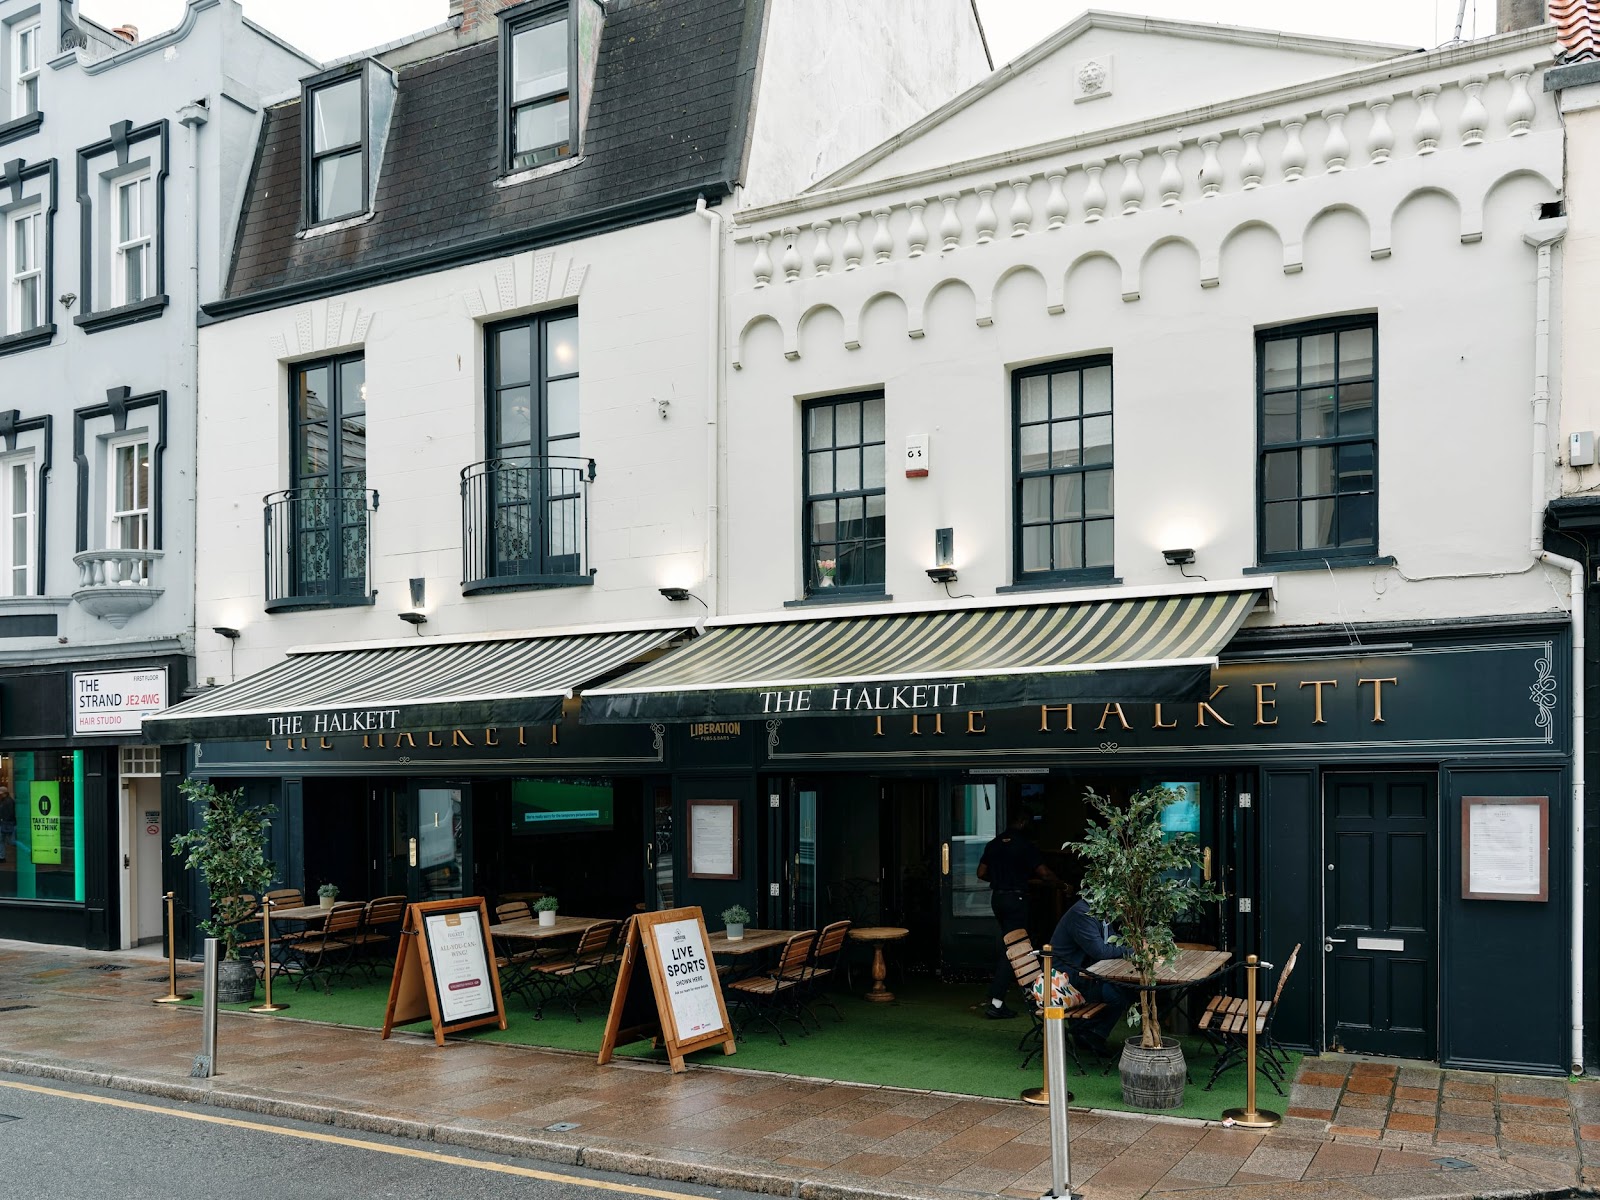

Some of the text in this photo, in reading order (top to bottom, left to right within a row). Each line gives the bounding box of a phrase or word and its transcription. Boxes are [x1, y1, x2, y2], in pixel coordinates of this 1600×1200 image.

[79, 679, 99, 692] THE
[79, 693, 160, 708] STRAND JE2 4WG
[759, 682, 966, 713] THE HALKETT
[1038, 677, 1397, 732] HALKETT
[79, 715, 122, 726] HAIR STUDIO
[267, 709, 400, 735] THE HALKETT
[691, 722, 740, 737] LIBERATION
[440, 941, 477, 951] ALL-YOU-CAN-
[672, 945, 694, 961] LIVE
[667, 958, 706, 977] SPORTS
[675, 975, 703, 987] SHOWN HERE
